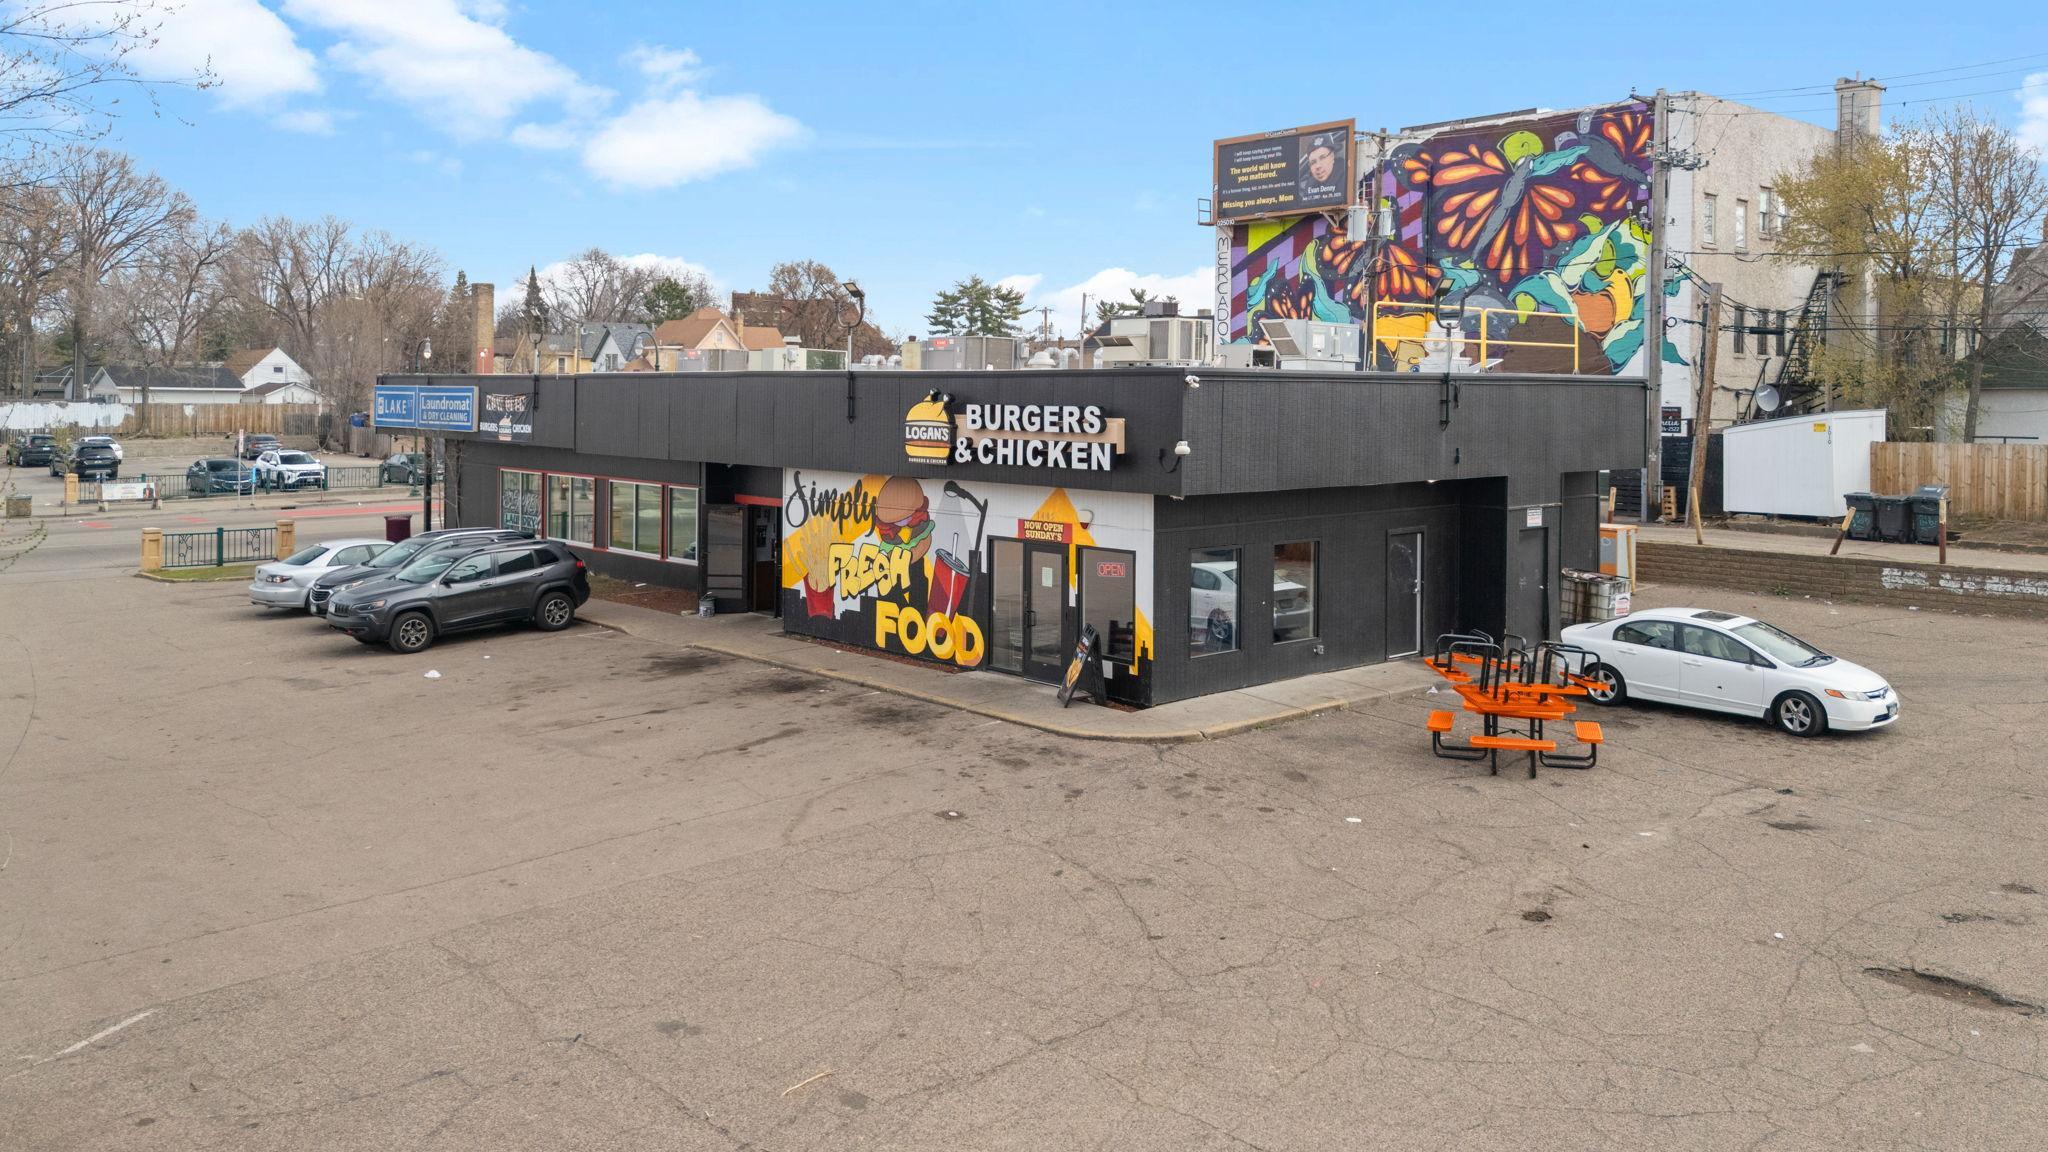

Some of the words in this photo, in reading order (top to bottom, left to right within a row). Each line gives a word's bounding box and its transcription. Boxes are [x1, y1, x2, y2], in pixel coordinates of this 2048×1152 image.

[1230, 167, 1240, 175] The
[1241, 164, 1258, 173] world
[1259, 162, 1269, 171] will
[1270, 161, 1286, 170] know
[1238, 175, 1248, 183] you
[1249, 169, 1278, 180] mattered.
[1320, 185, 1336, 193] Denny
[1222, 200, 1244, 209] Missing
[1244, 199, 1255, 208] you
[1256, 196, 1278, 205] always,
[1279, 194, 1294, 202] Mom
[1217, 237, 1230, 336] MERCADO
[385, 399, 407, 415] LAKE
[421, 396, 470, 410] Laundromat
[427, 412, 439, 421] DRY
[440, 411, 468, 422] CLEANING
[966, 404, 1102, 434] BURGERS
[480, 421, 499, 432] BURGERS
[513, 424, 532, 434] CHICKEN
[905, 426, 949, 441] LOGAN'S
[955, 437, 973, 463] &
[977, 438, 1111, 471] CHICKEN
[786, 471, 878, 537] Simply
[1024, 520, 1042, 530] NOW
[1043, 522, 1064, 533] OPEN
[1025, 530, 1063, 541] SUNDAY'S
[828, 542, 912, 600] FRESH
[1098, 563, 1124, 577] OPEN
[875, 600, 985, 667] FOOD
